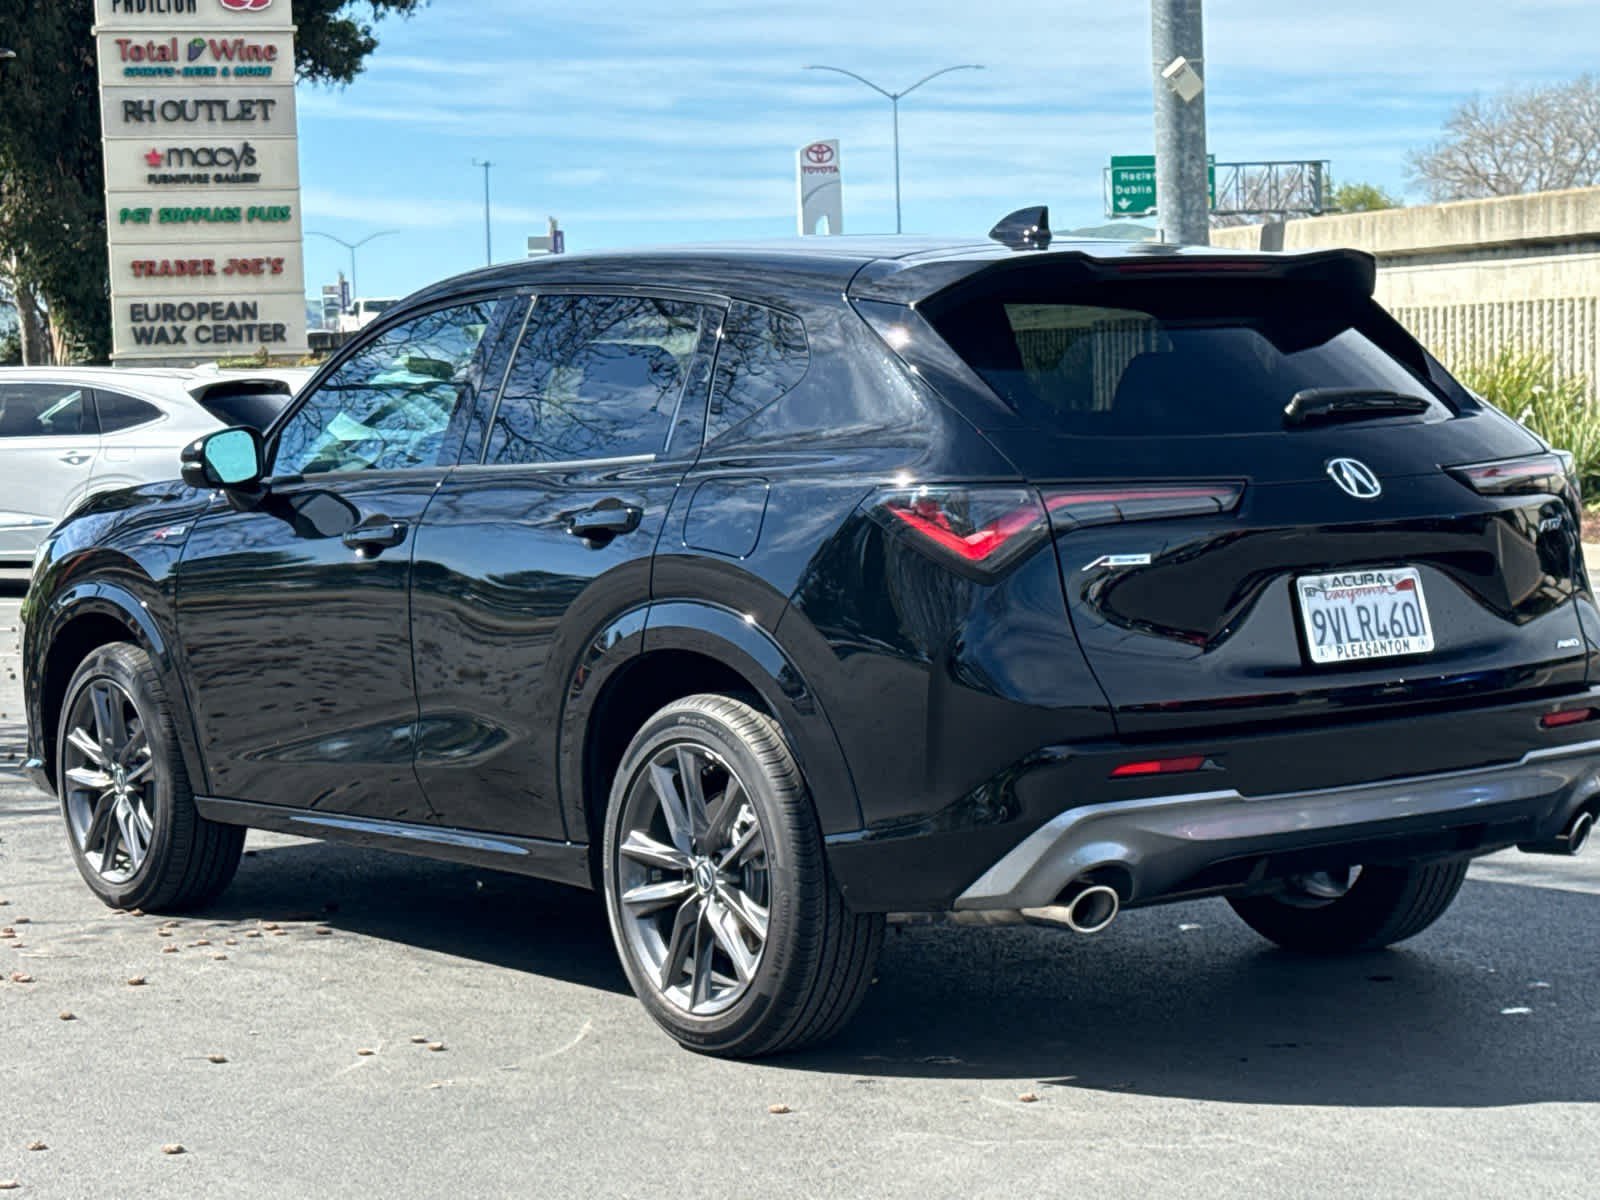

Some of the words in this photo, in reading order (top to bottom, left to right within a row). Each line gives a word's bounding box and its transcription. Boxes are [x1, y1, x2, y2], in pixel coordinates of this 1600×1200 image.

[115, 37, 179, 63] Total
[209, 38, 278, 62] Wine
[122, 100, 156, 122] RH
[160, 99, 276, 122] OUTLET
[167, 142, 257, 171] macy's
[148, 173, 210, 184] FURNITURE
[214, 173, 261, 183] GALLERY
[802, 165, 839, 175] TOYOTA
[159, 206, 242, 224] SUPPLIES
[247, 205, 291, 223] PLUS
[131, 259, 216, 277] TRADER
[222, 257, 285, 275] JOE'S
[130, 301, 258, 322] EUROPEAN
[131, 325, 187, 345] WAX
[194, 323, 286, 344] CENTER
[1331, 573, 1386, 588] ACURA
[1311, 601, 1420, 646] 9VLR460
[1336, 640, 1410, 658] PLEASANTON
